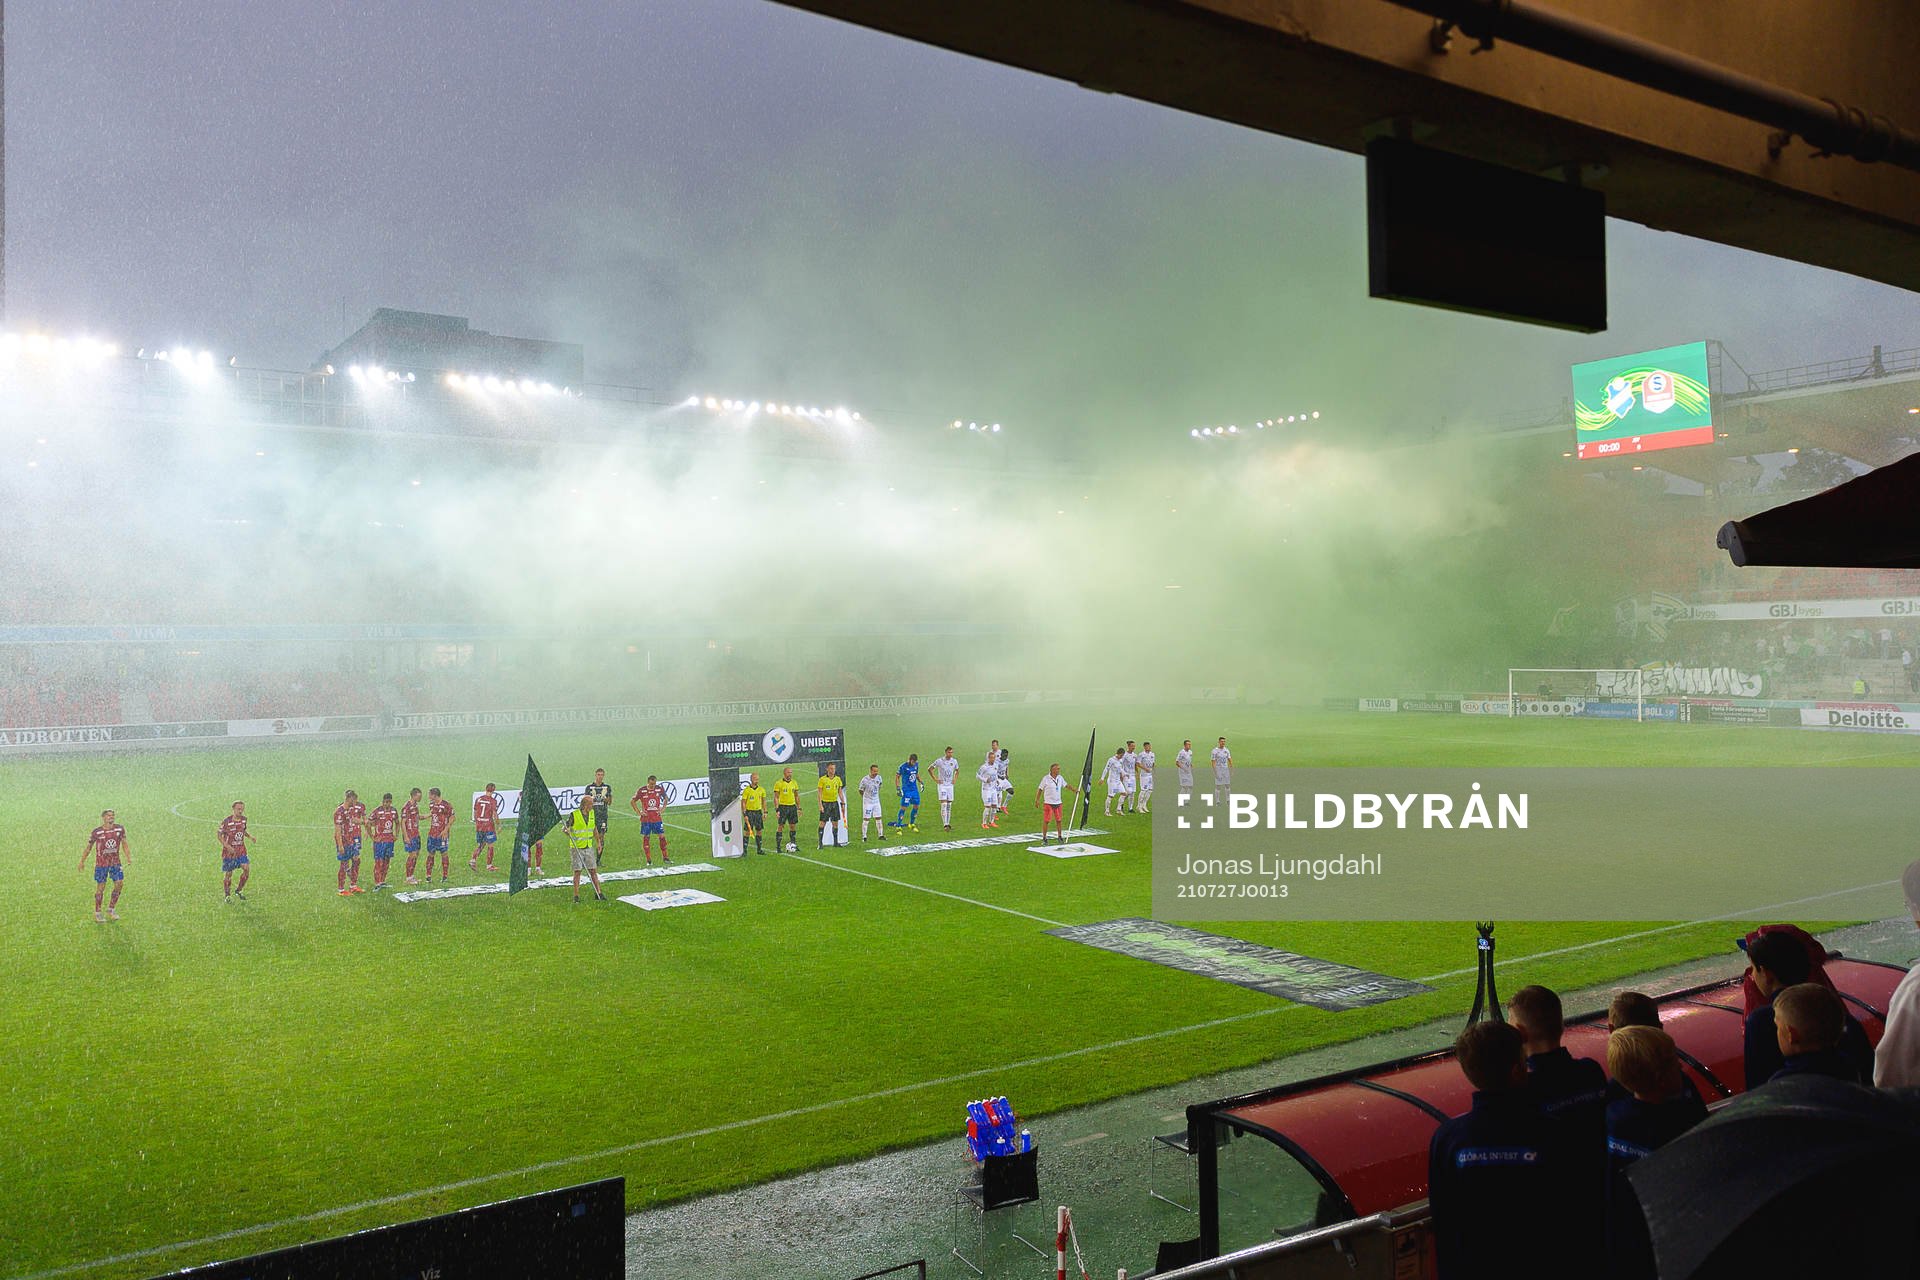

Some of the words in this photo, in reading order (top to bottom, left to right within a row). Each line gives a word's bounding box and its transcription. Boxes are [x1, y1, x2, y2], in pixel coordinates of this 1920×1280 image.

[1598, 442, 1620, 453] 00:00
[1769, 604, 1797, 618] GBJ
[1881, 601, 1913, 615] GBJ
[134, 627, 176, 640] VISMA
[843, 699, 865, 710] DEN
[1366, 699, 1391, 708] TIVAB
[15, 728, 113, 744] IDROTTEN
[800, 736, 837, 748] UNIBET
[716, 741, 755, 753] UNIBET
[721, 820, 733, 835] U
[1313, 982, 1386, 1000] UNIBET
[1458, 1152, 1488, 1162] GLOBAL
[1489, 1151, 1519, 1161] INVEST
